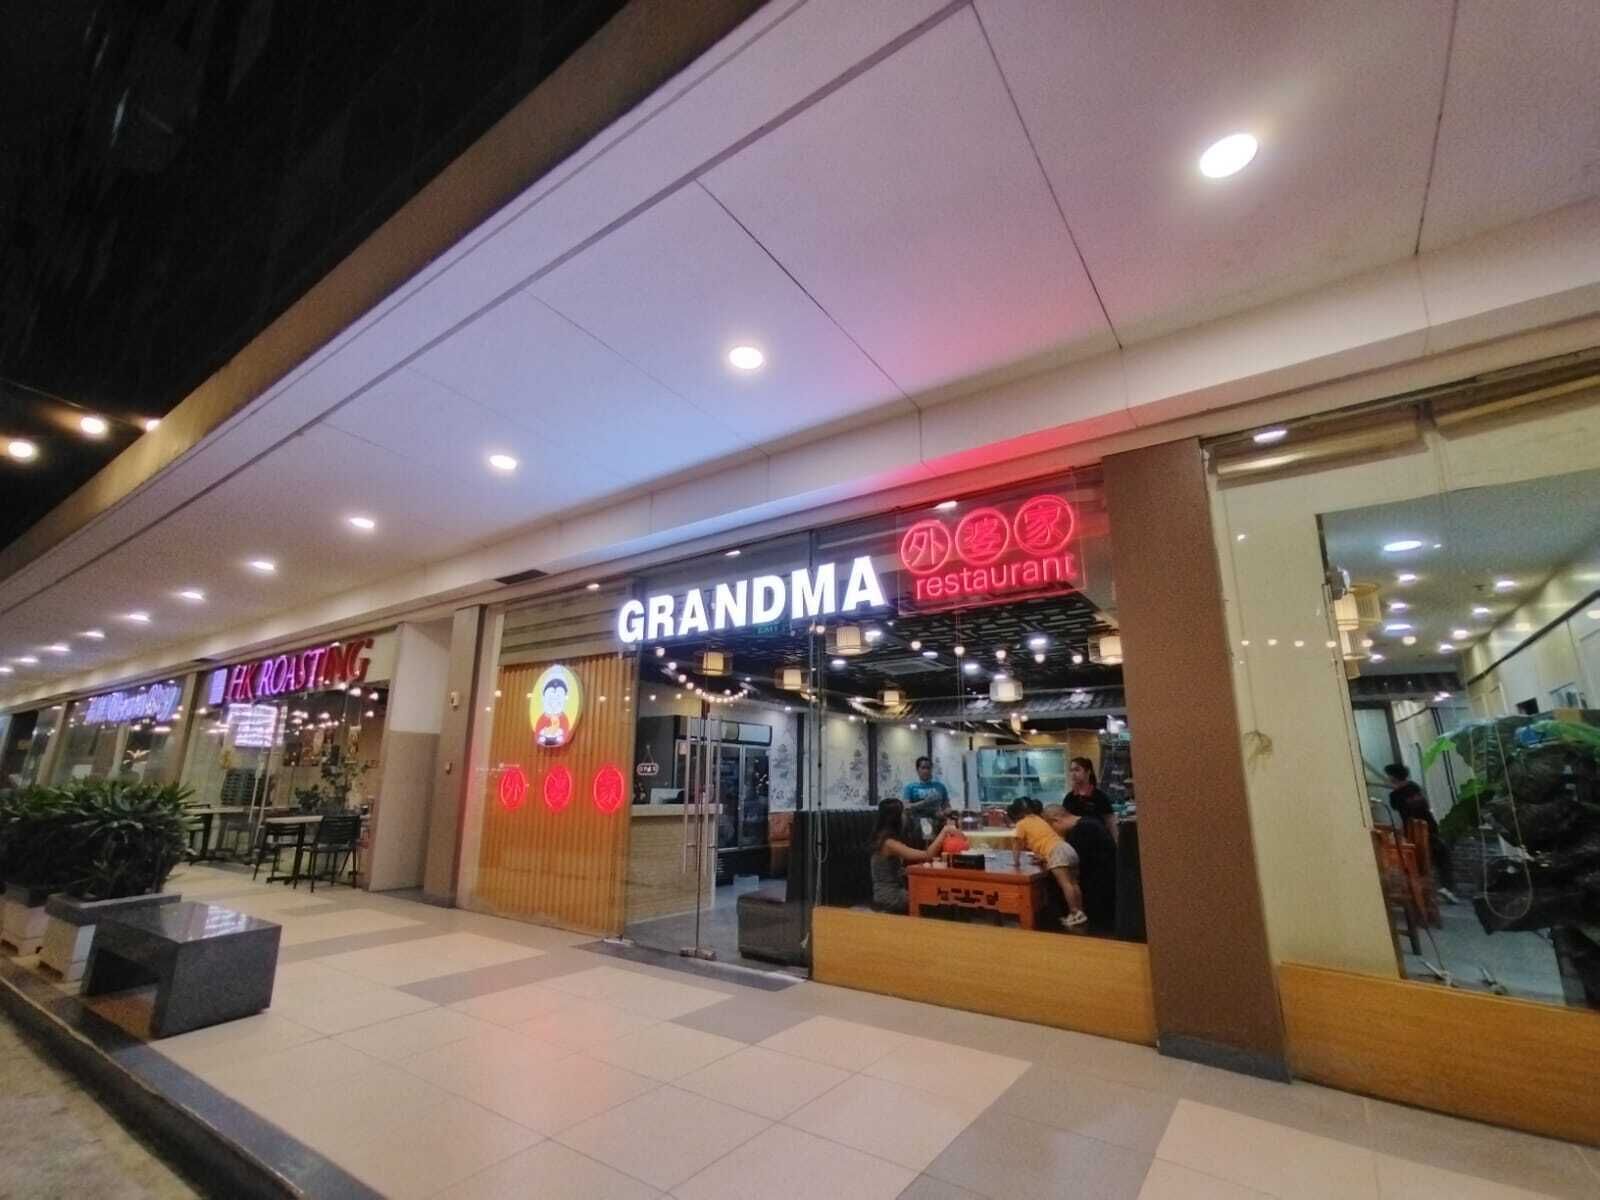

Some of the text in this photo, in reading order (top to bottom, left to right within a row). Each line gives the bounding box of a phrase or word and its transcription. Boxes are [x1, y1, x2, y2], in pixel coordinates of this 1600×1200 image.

[618, 555, 884, 643] GRANDMA
[916, 553, 1077, 600] restaurant
[226, 662, 258, 700] HK
[256, 639, 374, 696] ROASTING
